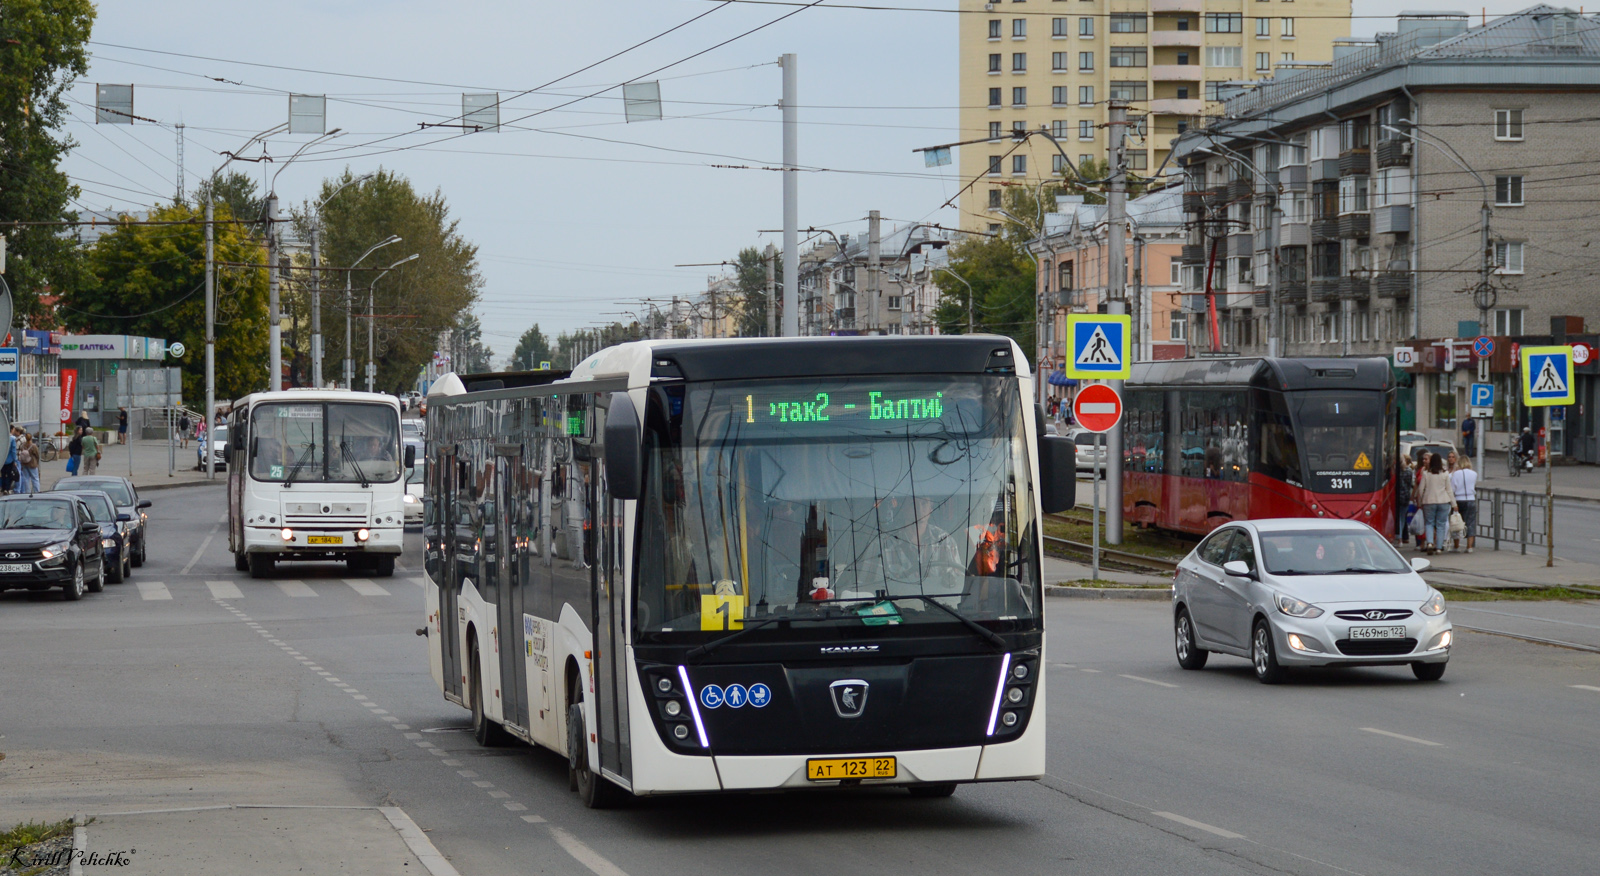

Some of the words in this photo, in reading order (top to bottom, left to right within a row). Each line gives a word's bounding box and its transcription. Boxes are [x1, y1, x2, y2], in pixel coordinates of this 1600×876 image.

[80, 343, 115, 351] ЕАПТЕКА
[1477, 387, 1490, 405] P
[278, 407, 288, 417] 25
[746, 394, 755, 423] 1
[1334, 402, 1340, 414] 1
[270, 466, 282, 478] 25
[1331, 478, 1353, 489] 3311
[715, 601, 730, 631] 1
[1352, 628, 1389, 638] Е469МВ
[1390, 627, 1404, 635] 122
[820, 645, 880, 654] KAMAZ
[816, 765, 833, 777] АТ
[841, 761, 867, 776] 123
[875, 759, 890, 771] 22
